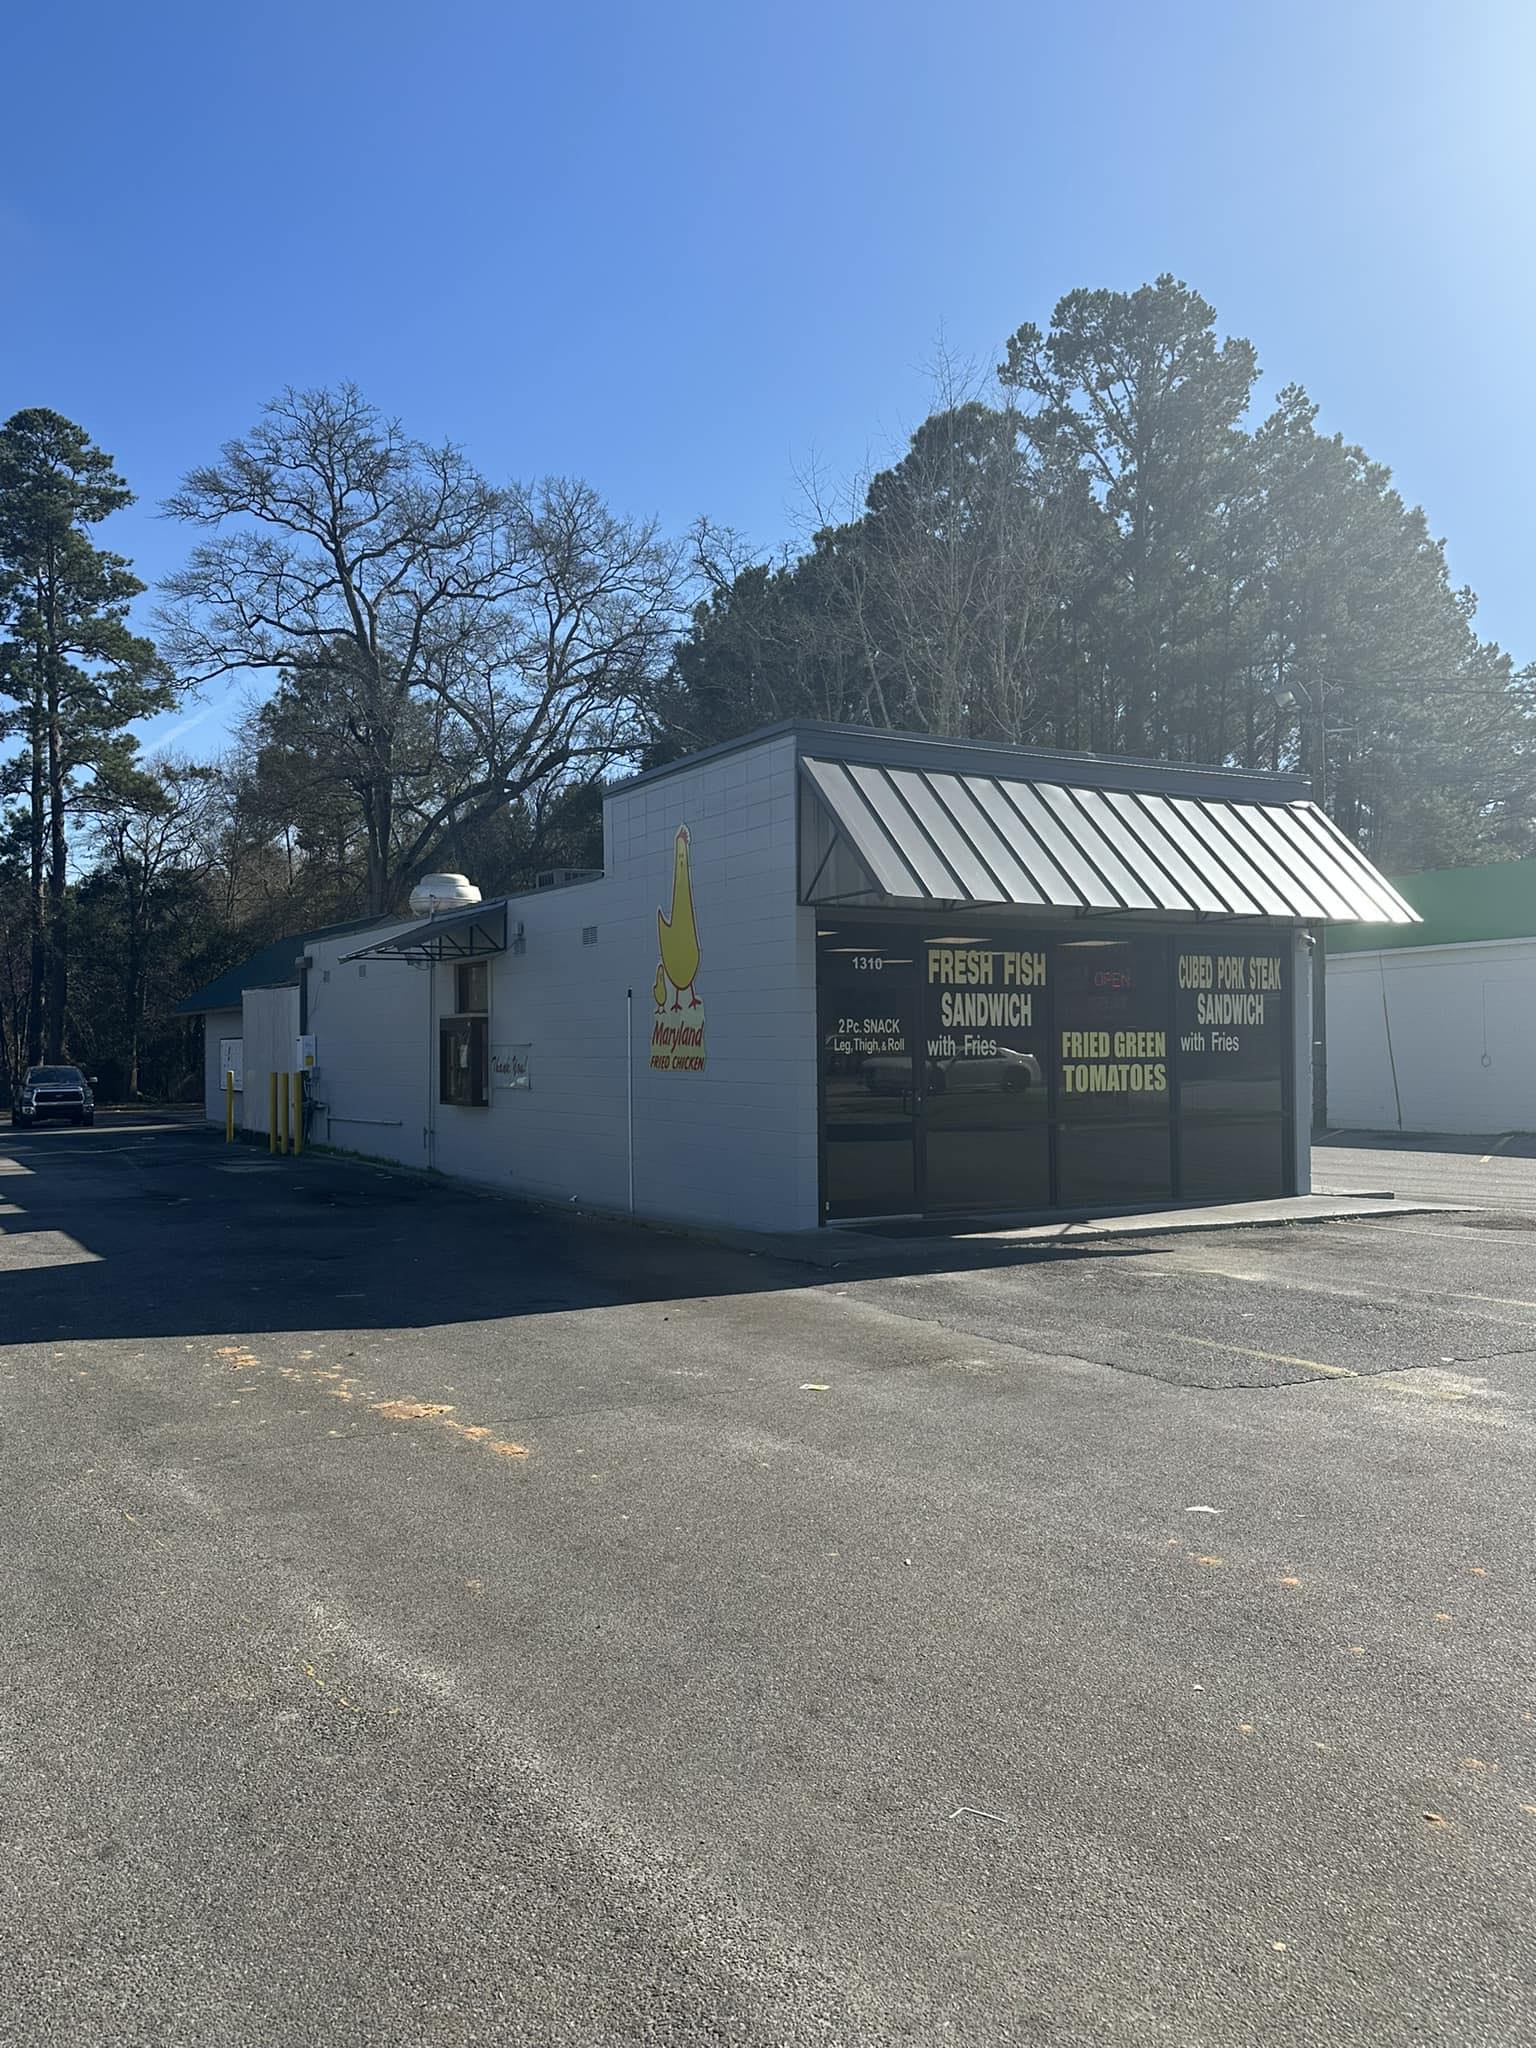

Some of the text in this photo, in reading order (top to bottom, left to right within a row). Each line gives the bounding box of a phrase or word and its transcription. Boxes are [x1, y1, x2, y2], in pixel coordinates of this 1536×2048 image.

[852, 957, 882, 970] 1310
[928, 949, 1046, 986] FRESH FISH
[1179, 955, 1281, 990] CUBED PORK STEAK
[941, 991, 1032, 1027] SANDWICH
[1197, 992, 1264, 1025] SANDWICH
[651, 1020, 705, 1054] Maryland
[863, 1018, 900, 1034] SNACK
[887, 1038, 905, 1052] Roll
[927, 1034, 997, 1057] with Fries
[1062, 1031, 1166, 1058] FRIED GREEN
[1180, 1032, 1240, 1052] with Fries
[650, 1055, 705, 1071] FRIED CHICKEN
[1062, 1063, 1166, 1092] TOMATOES
